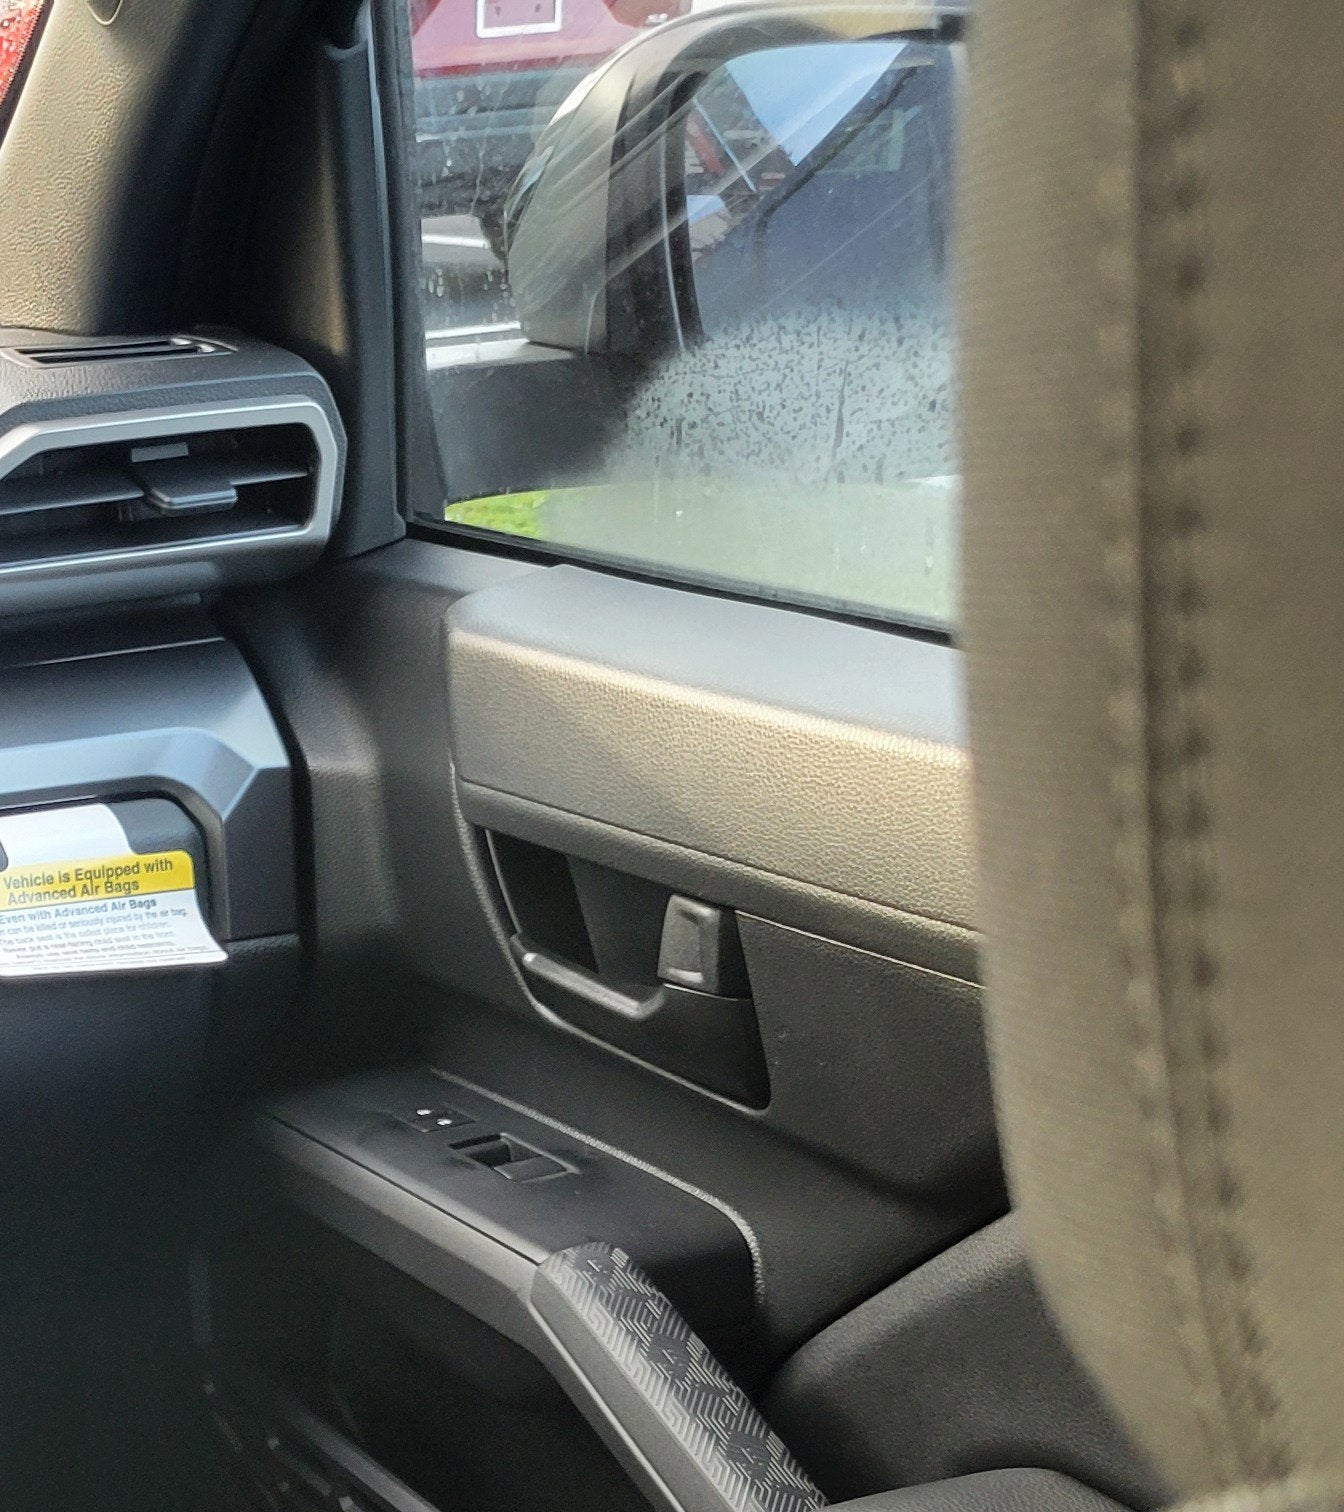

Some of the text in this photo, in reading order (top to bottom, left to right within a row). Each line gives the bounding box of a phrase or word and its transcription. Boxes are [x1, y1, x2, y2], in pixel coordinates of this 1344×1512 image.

[3, 873, 54, 890] Vehicle
[58, 870, 71, 884] is
[74, 861, 140, 885] Equipped
[143, 858, 173, 874] with
[7, 879, 140, 906] Advanced Air Bags
[23, 924, 34, 932] be
[36, 922, 56, 931] killed
[146, 911, 157, 919] the
[29, 910, 53, 922] with
[55, 904, 108, 919] Advanced
[110, 901, 127, 913] Air
[129, 897, 157, 911] Bags
